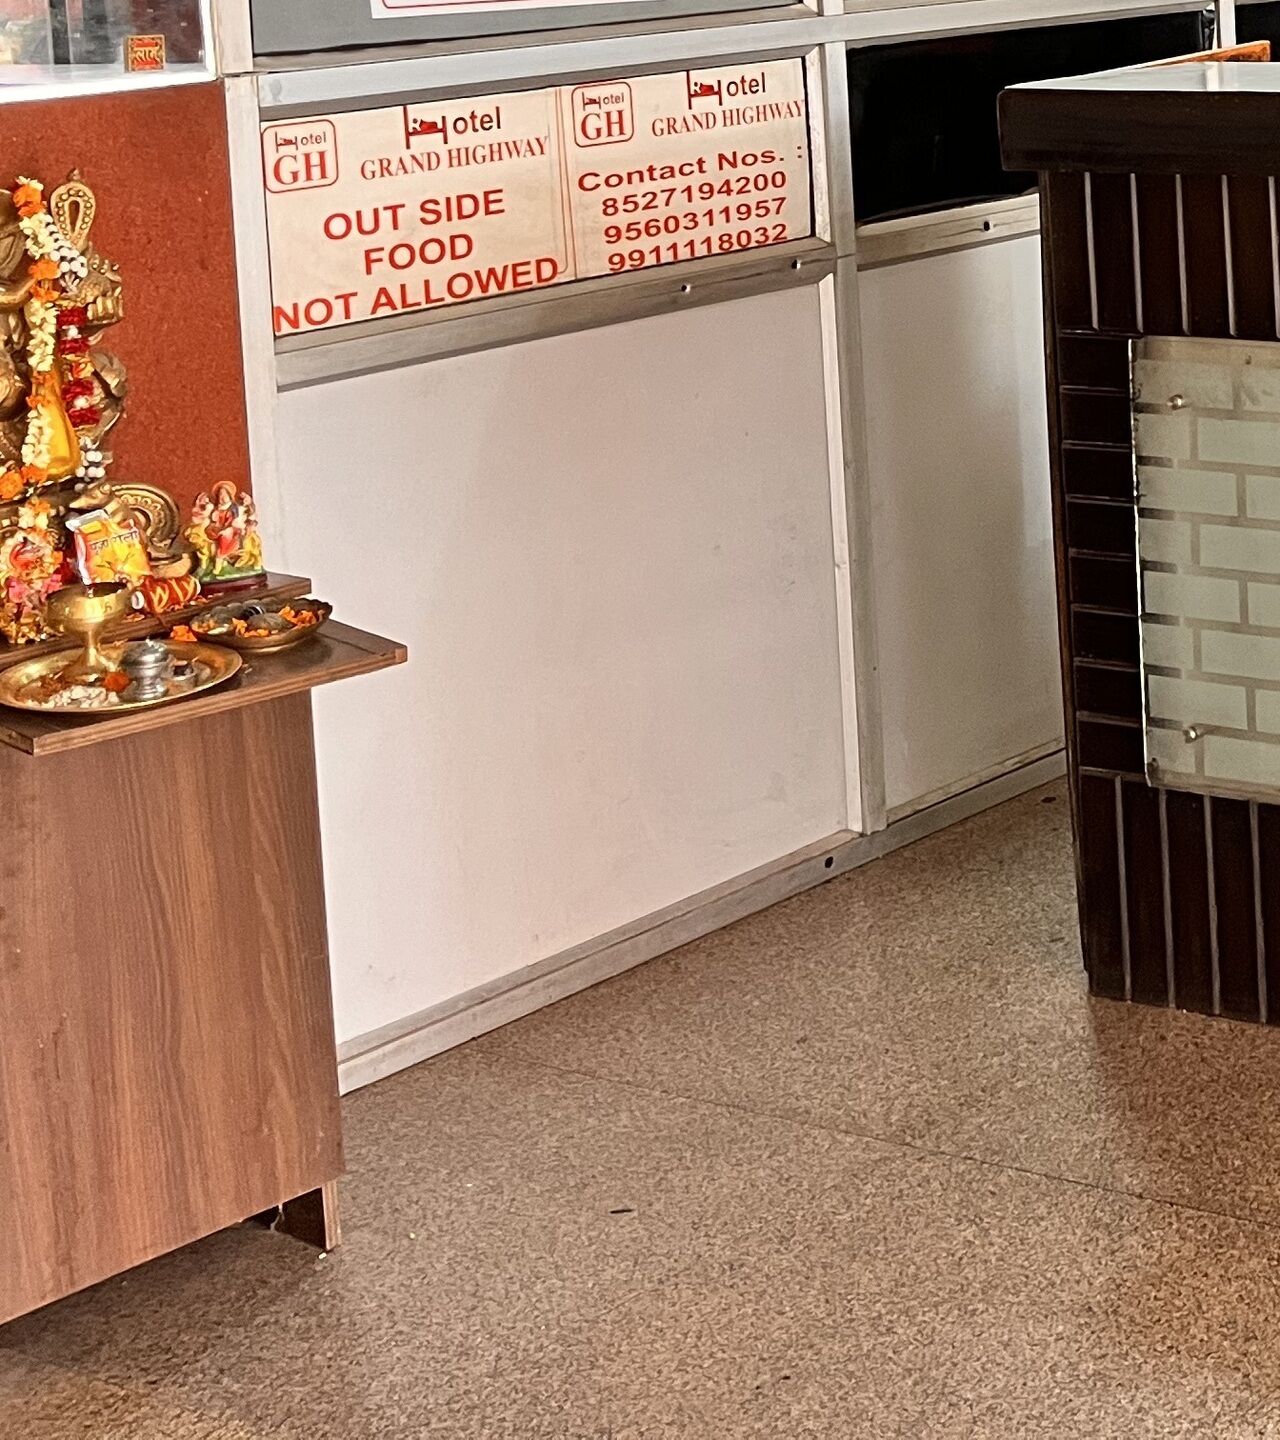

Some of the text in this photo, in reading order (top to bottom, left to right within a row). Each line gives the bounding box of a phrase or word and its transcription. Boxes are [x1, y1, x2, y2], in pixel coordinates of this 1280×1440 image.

[687, 71, 767, 109] Hotel
[403, 105, 502, 150] Hotel
[580, 108, 626, 142] GH
[651, 100, 804, 138] GRAND HIGHWAY
[273, 152, 329, 186] GH
[360, 135, 548, 181] GRAND HIGHWAY
[577, 157, 707, 192] Contact
[717, 144, 786, 170] Nos.
[323, 188, 506, 241] OUT SIDE
[601, 170, 788, 218] 8527194200
[604, 196, 788, 244] 9560311957
[363, 233, 474, 275] FOOD
[607, 223, 789, 274] 9911118032
[274, 256, 559, 333] NOT ALLOWED
